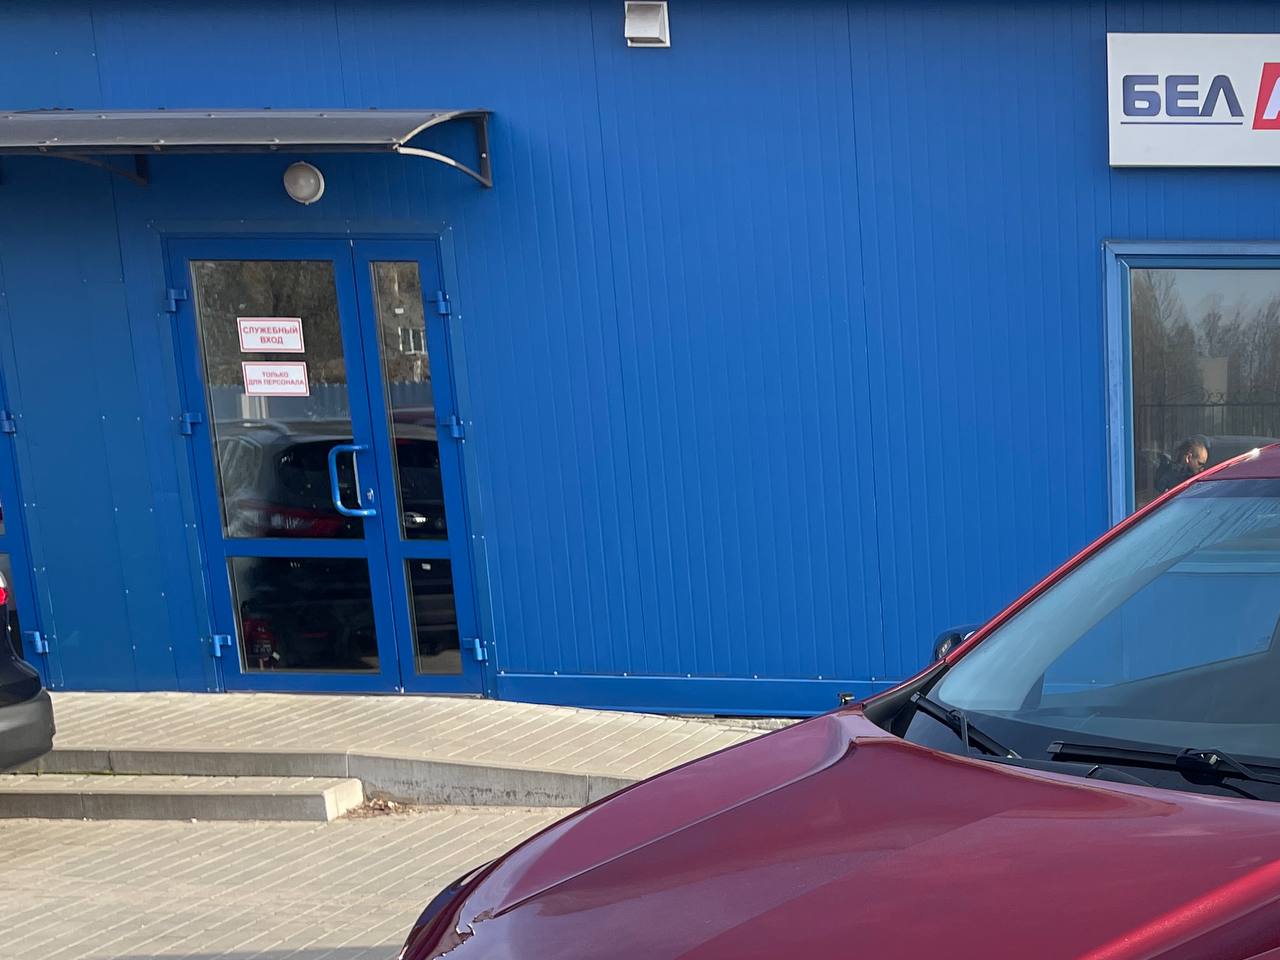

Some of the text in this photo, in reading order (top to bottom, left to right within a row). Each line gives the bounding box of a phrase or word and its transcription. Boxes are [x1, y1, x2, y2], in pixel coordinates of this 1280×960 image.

[1120, 74, 1244, 118] БЕЛ
[242, 325, 298, 334] СЛУЖЕБНЫЙ
[260, 336, 283, 345] ВХОД
